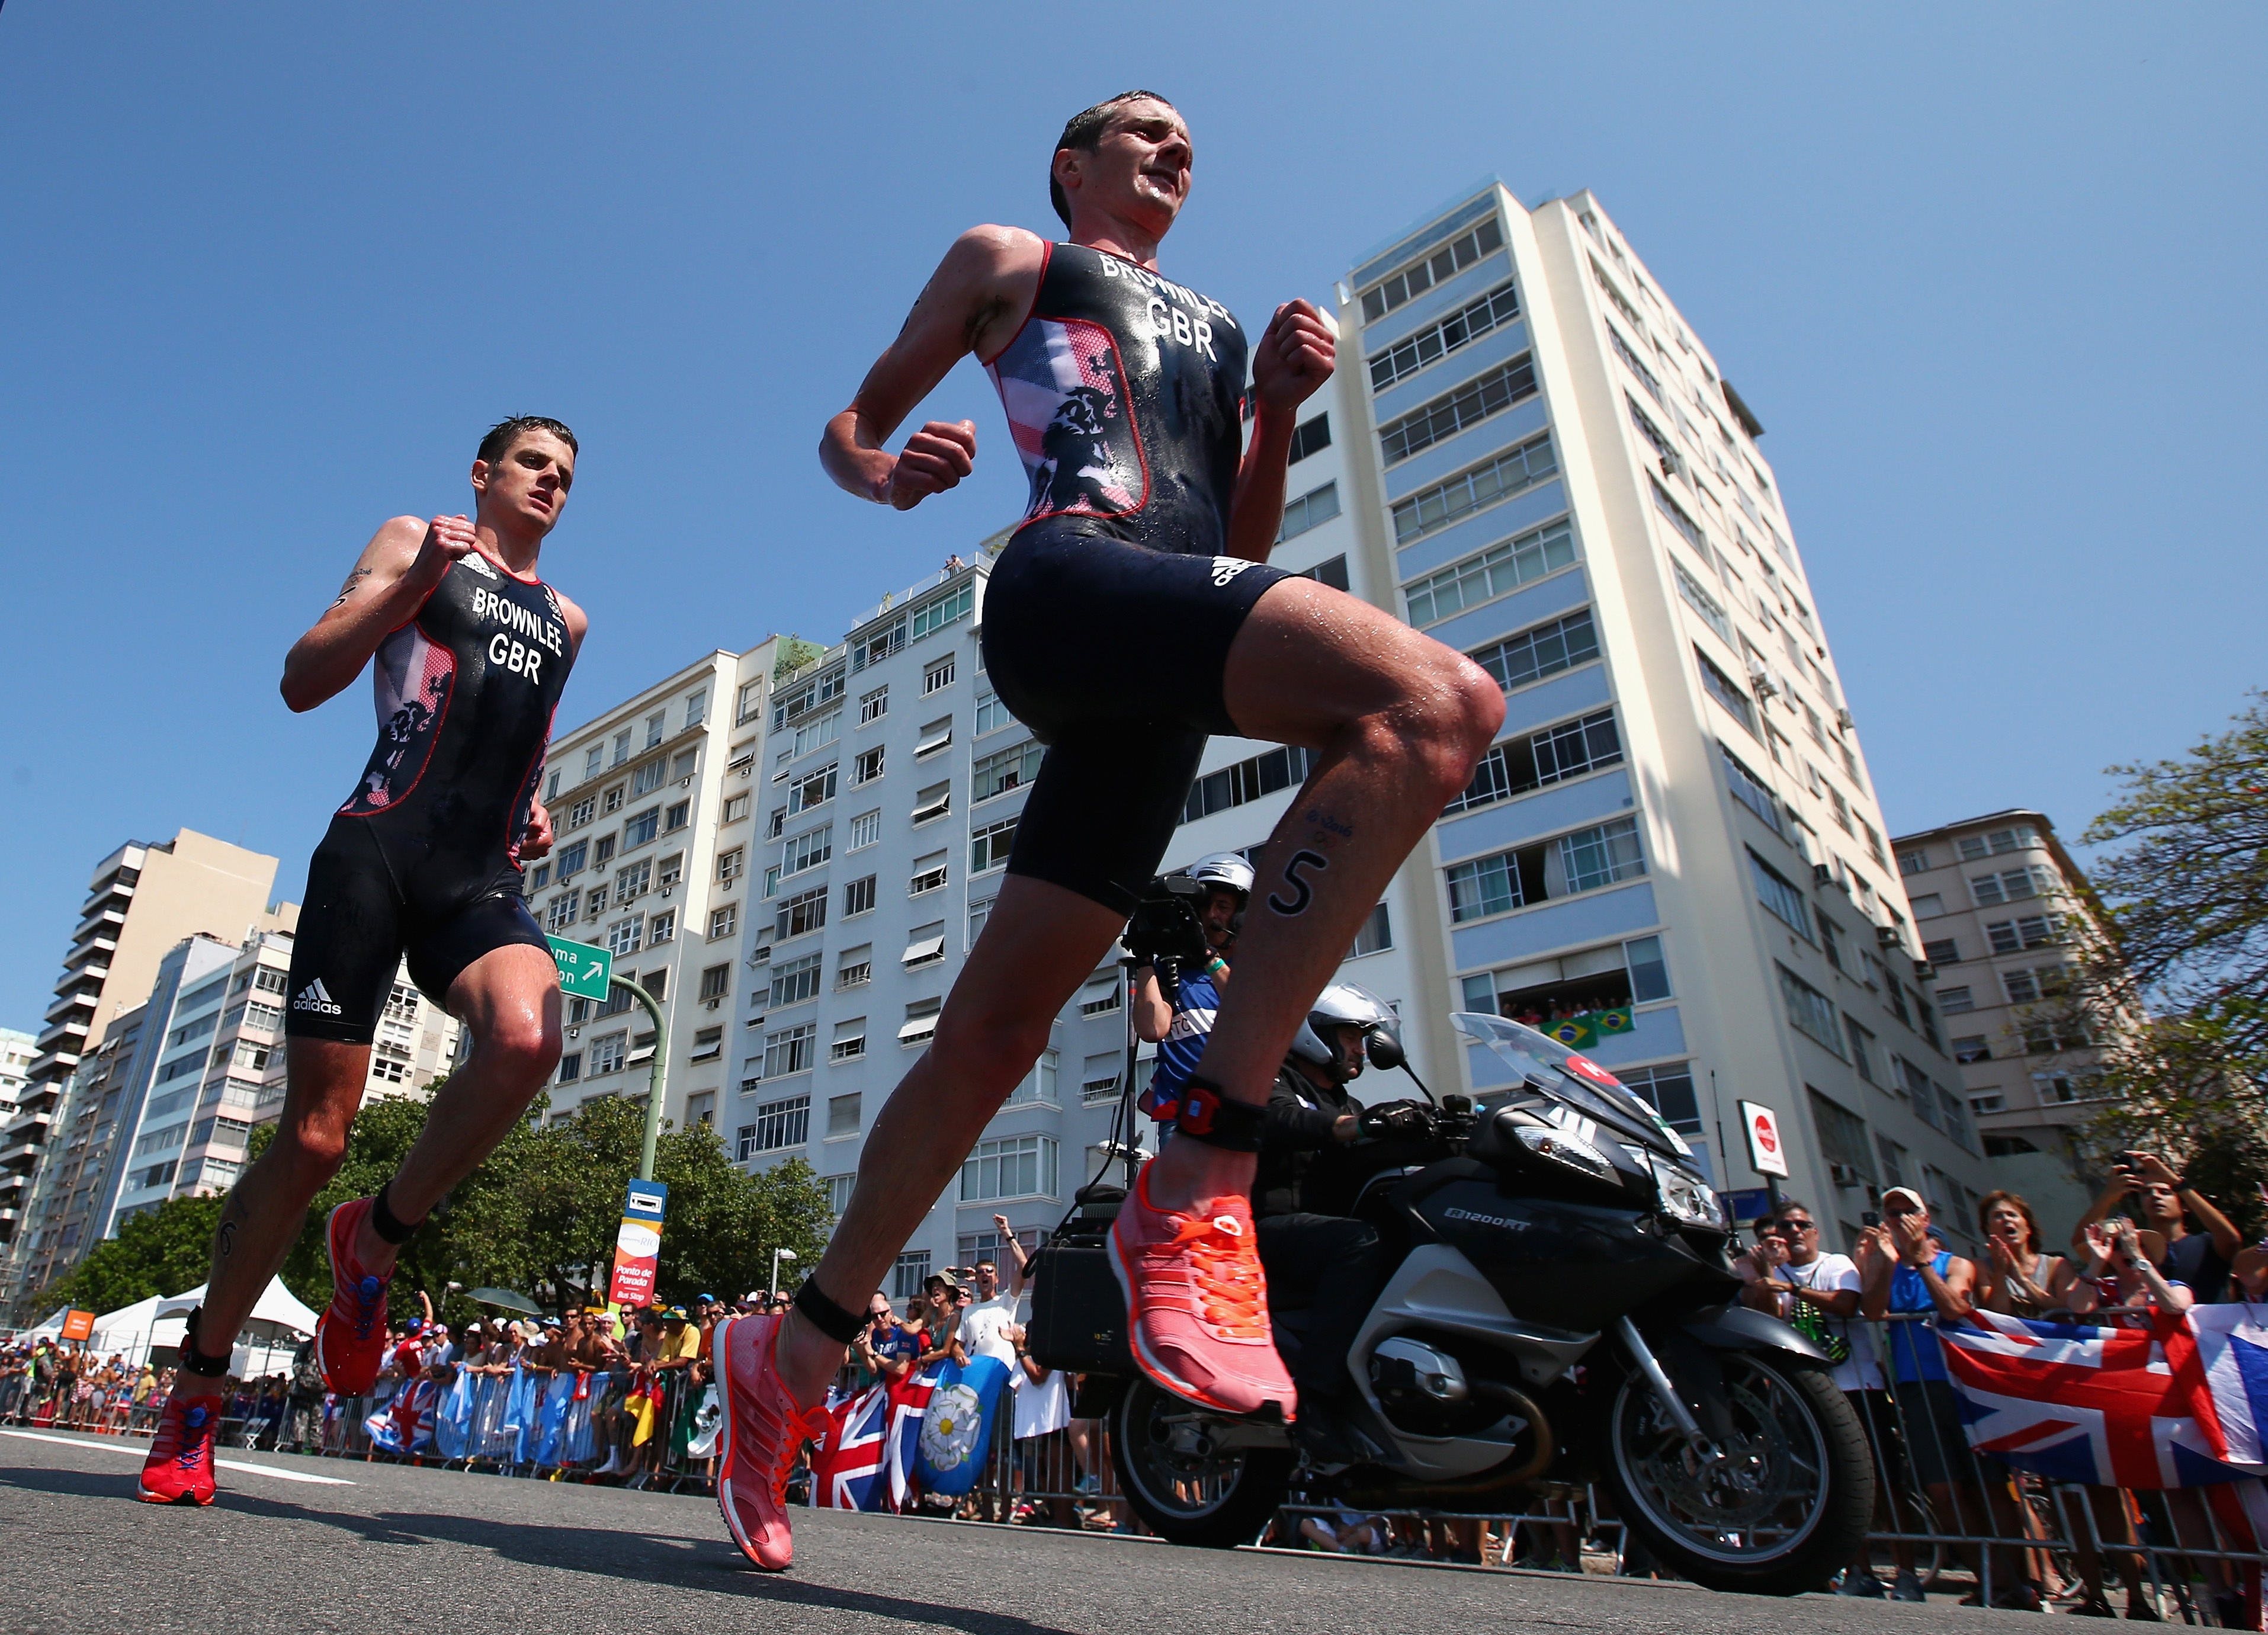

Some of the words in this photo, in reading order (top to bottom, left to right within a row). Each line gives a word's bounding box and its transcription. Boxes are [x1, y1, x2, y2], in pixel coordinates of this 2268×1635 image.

[1099, 254, 1237, 329] BROWNLEE
[1146, 297, 1217, 363] GBR
[472, 586, 562, 658] BROWNLEE
[489, 633, 541, 685] GBR
[1268, 848, 1329, 917] 5
[554, 948, 578, 964] ma
[558, 970, 575, 984] on
[293, 998, 342, 1015] adidas
[1170, 1017, 1191, 1036] TC
[219, 1220, 238, 1257] 6
[640, 1237, 658, 1248] RIO
[616, 1265, 641, 1277] Ponto
[641, 1269, 653, 1278] de
[618, 1275, 648, 1287] Parada
[617, 1291, 629, 1299] Bus
[629, 1292, 645, 1302] Stop
